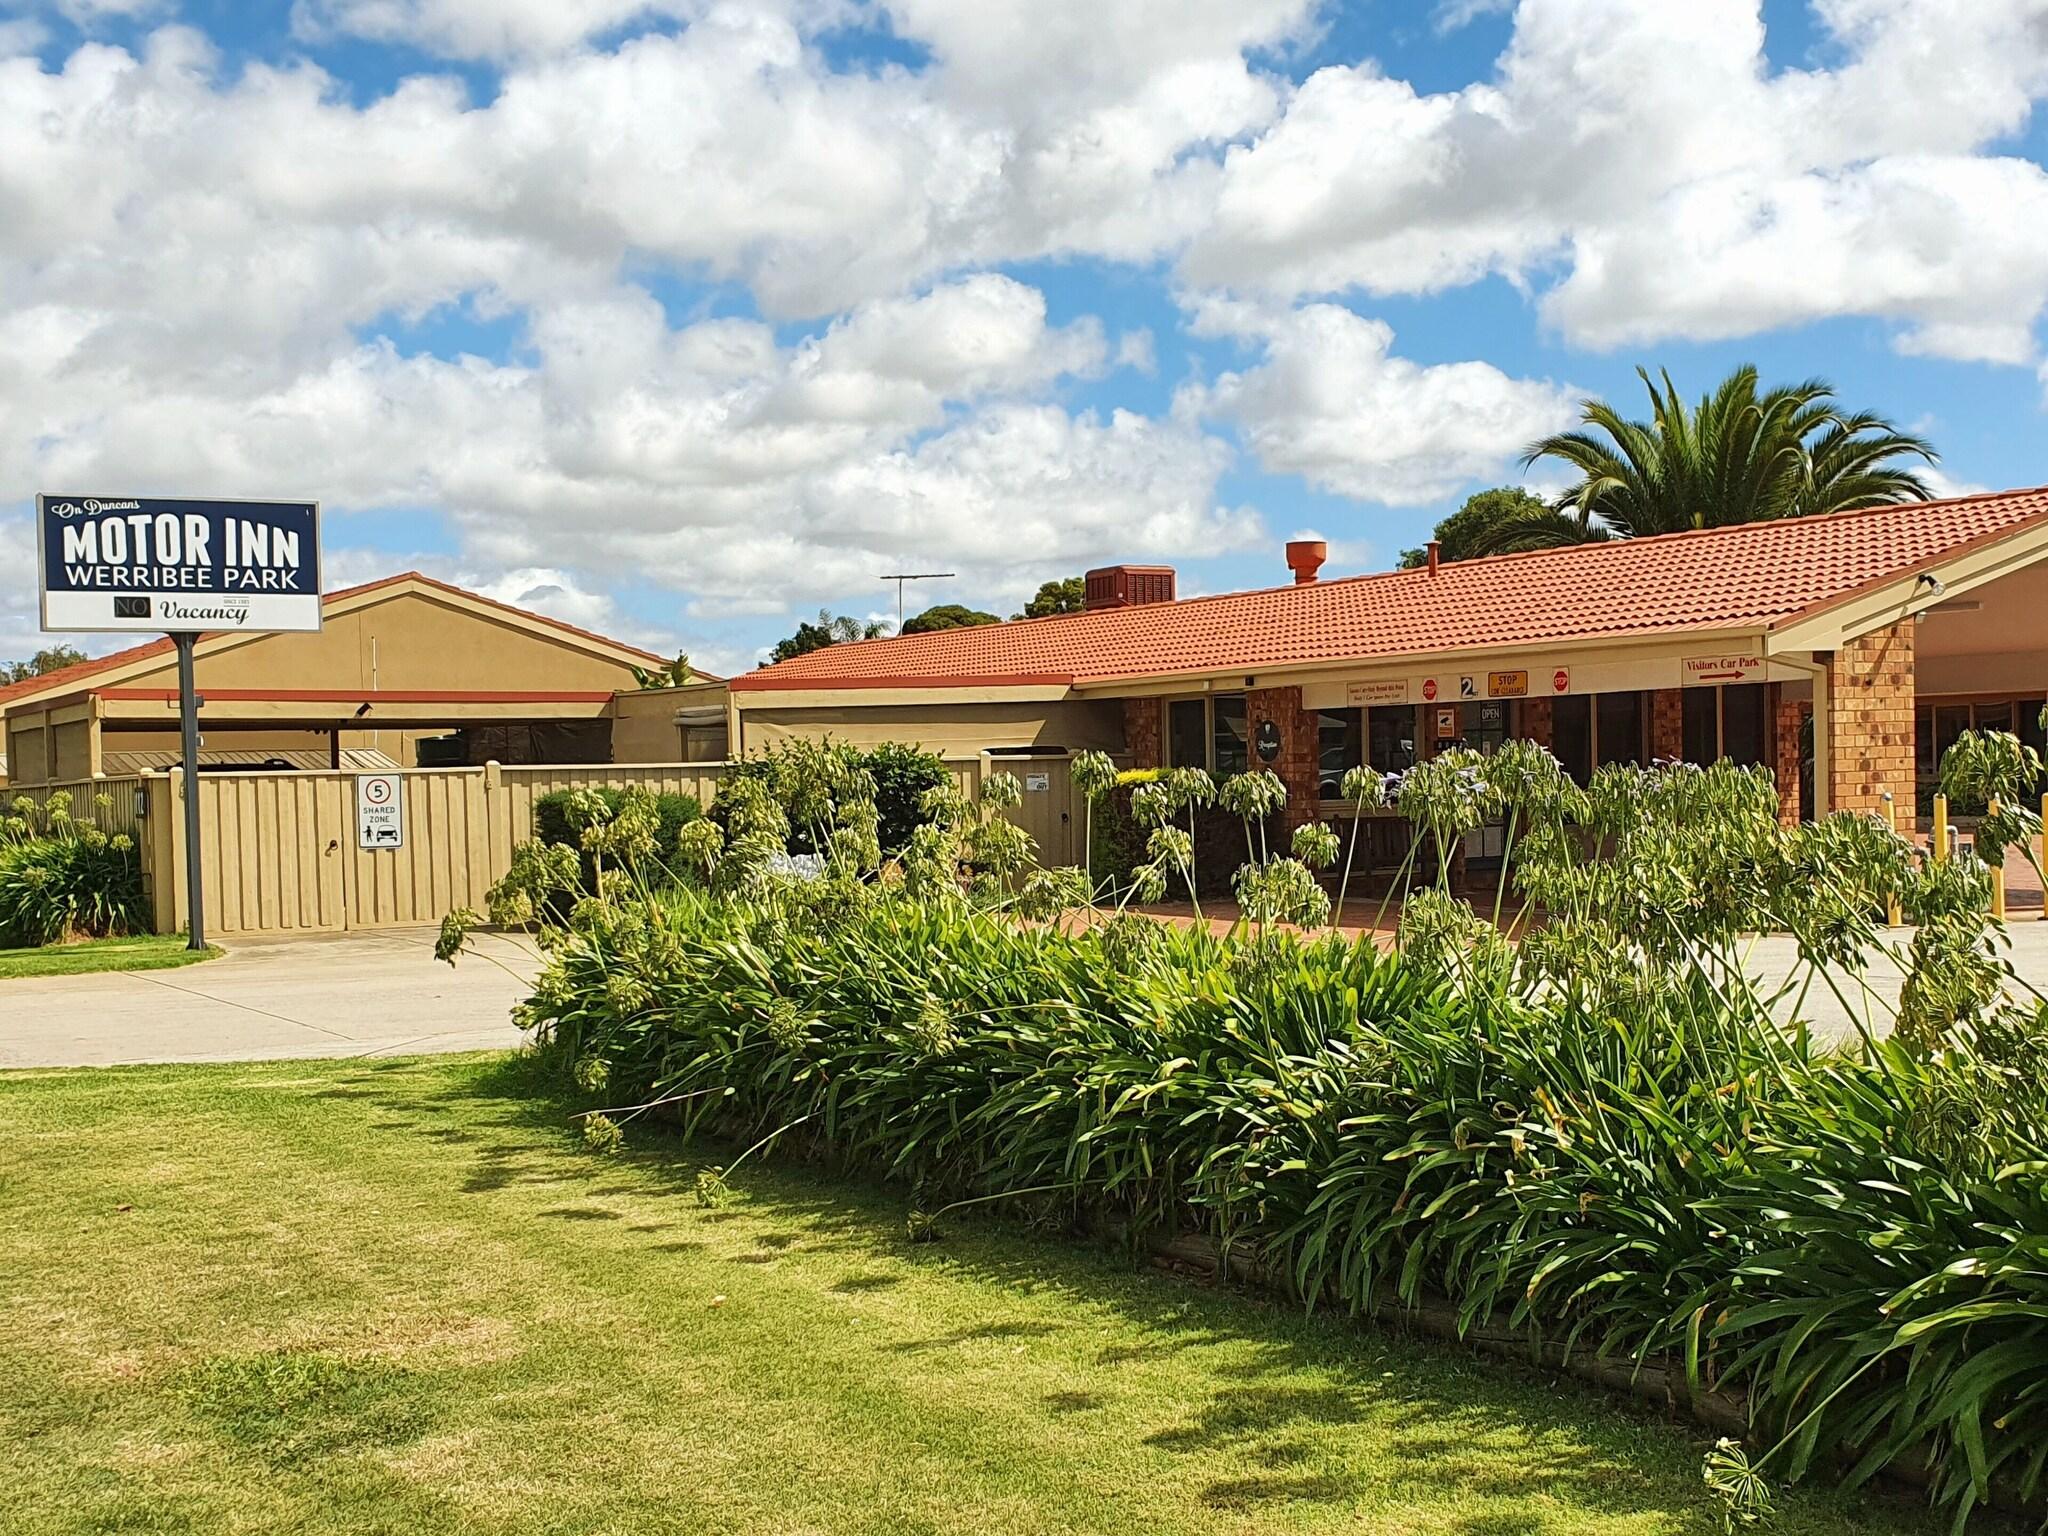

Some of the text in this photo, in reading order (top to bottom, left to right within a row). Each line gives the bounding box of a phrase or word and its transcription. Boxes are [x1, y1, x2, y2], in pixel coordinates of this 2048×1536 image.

[51, 499, 141, 519] On Duncans
[63, 513, 300, 568] MOTOR INN
[65, 565, 300, 590] WERRIBEE PARK
[115, 598, 250, 626] NO Vacancy
[1687, 656, 1760, 671] Visitors Car Park
[1461, 678, 1473, 698] 2
[1498, 675, 1518, 686] STOP
[1481, 708, 1500, 721] OPEN
[373, 784, 384, 798] 5
[363, 806, 396, 815] SHARED
[369, 815, 391, 824] ZONE
